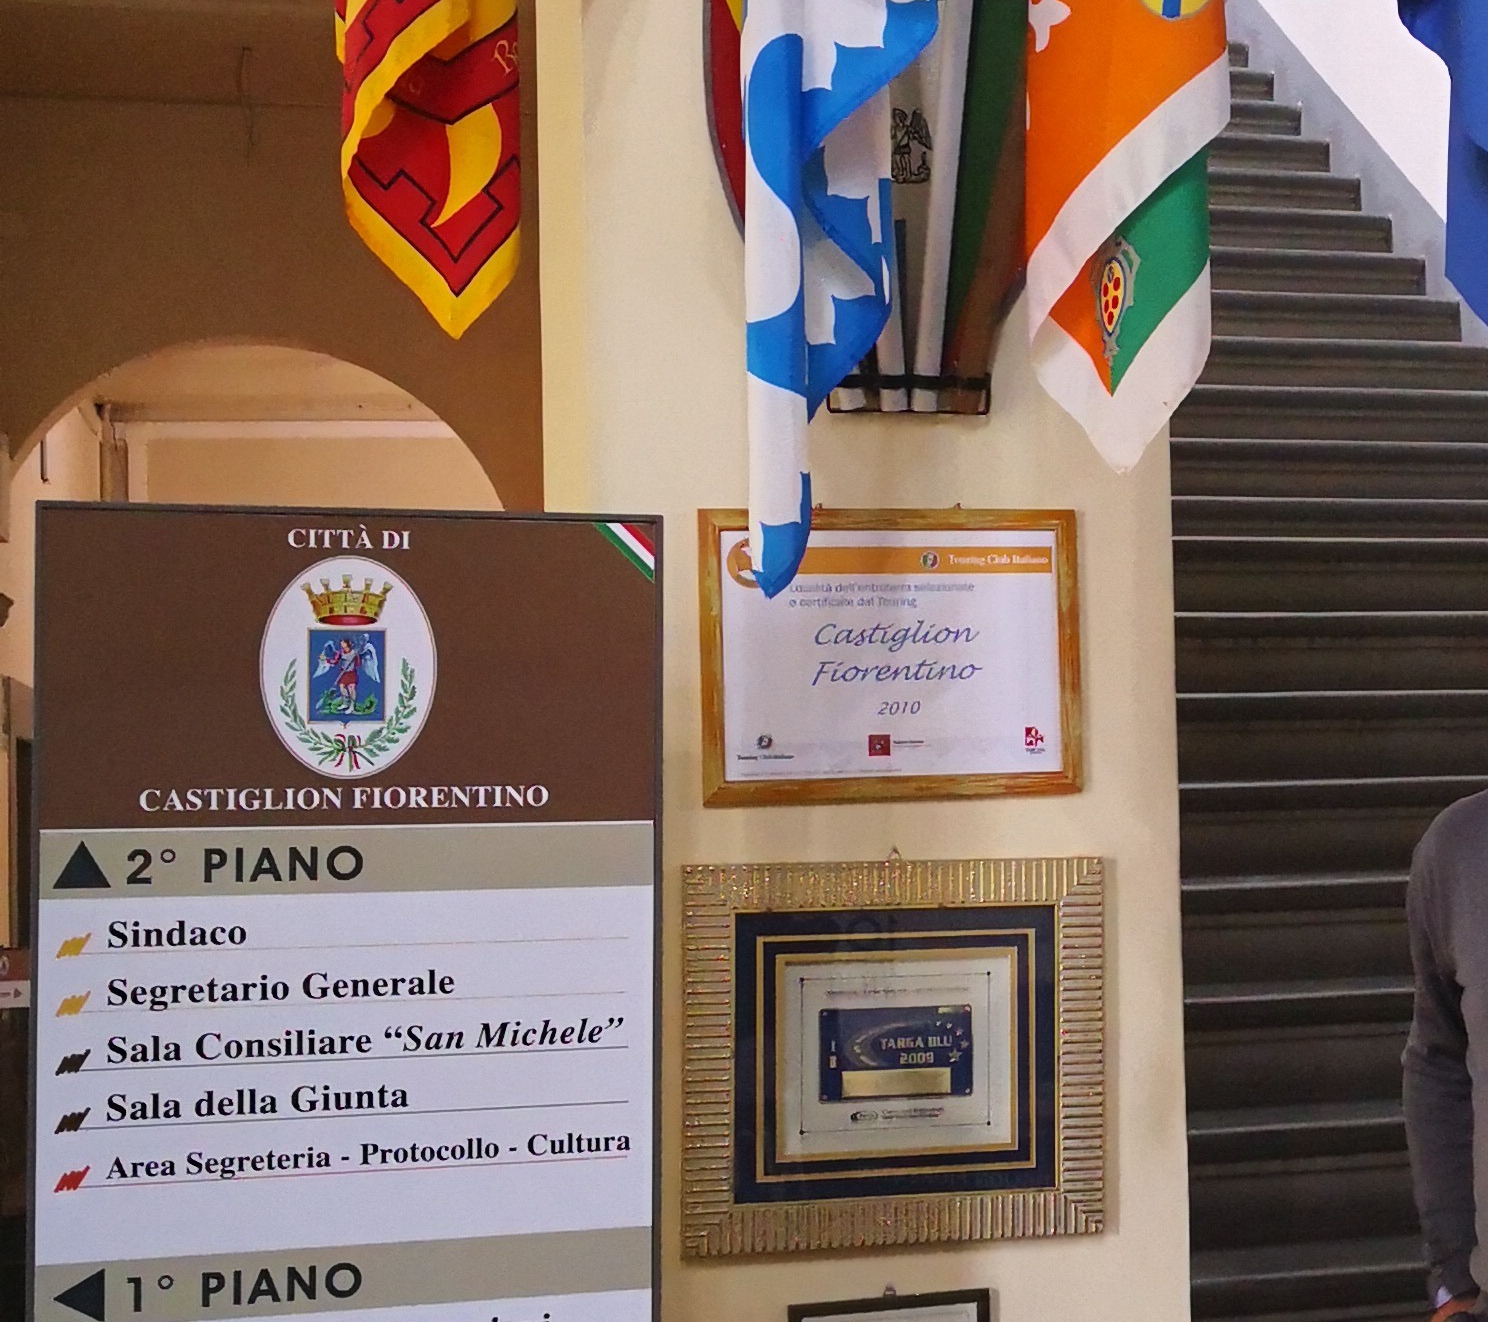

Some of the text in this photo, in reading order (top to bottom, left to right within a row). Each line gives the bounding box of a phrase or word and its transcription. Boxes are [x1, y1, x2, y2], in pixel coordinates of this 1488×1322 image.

[287, 523, 410, 550] CITTÀ DI
[814, 620, 980, 653] Castiglion
[811, 659, 983, 686] Fiorentino
[877, 700, 921, 716] 2010
[139, 784, 549, 812] CASTIGLION FIORENTINO
[126, 845, 364, 885] 2° PIANO
[107, 920, 247, 949] Sindaco
[107, 969, 455, 1012] Segretario Generale
[107, 1017, 624, 1064] Sala Consiliare “San Michele”
[899, 1051, 934, 1065] 2009
[106, 1084, 409, 1122] Sala della Giunta
[105, 1156, 176, 1180] Area
[186, 1146, 331, 1180] Segreteria
[360, 1137, 500, 1166] Protocollo
[527, 1132, 631, 1157] Cultura
[126, 1262, 363, 1313] 1° PIANO
